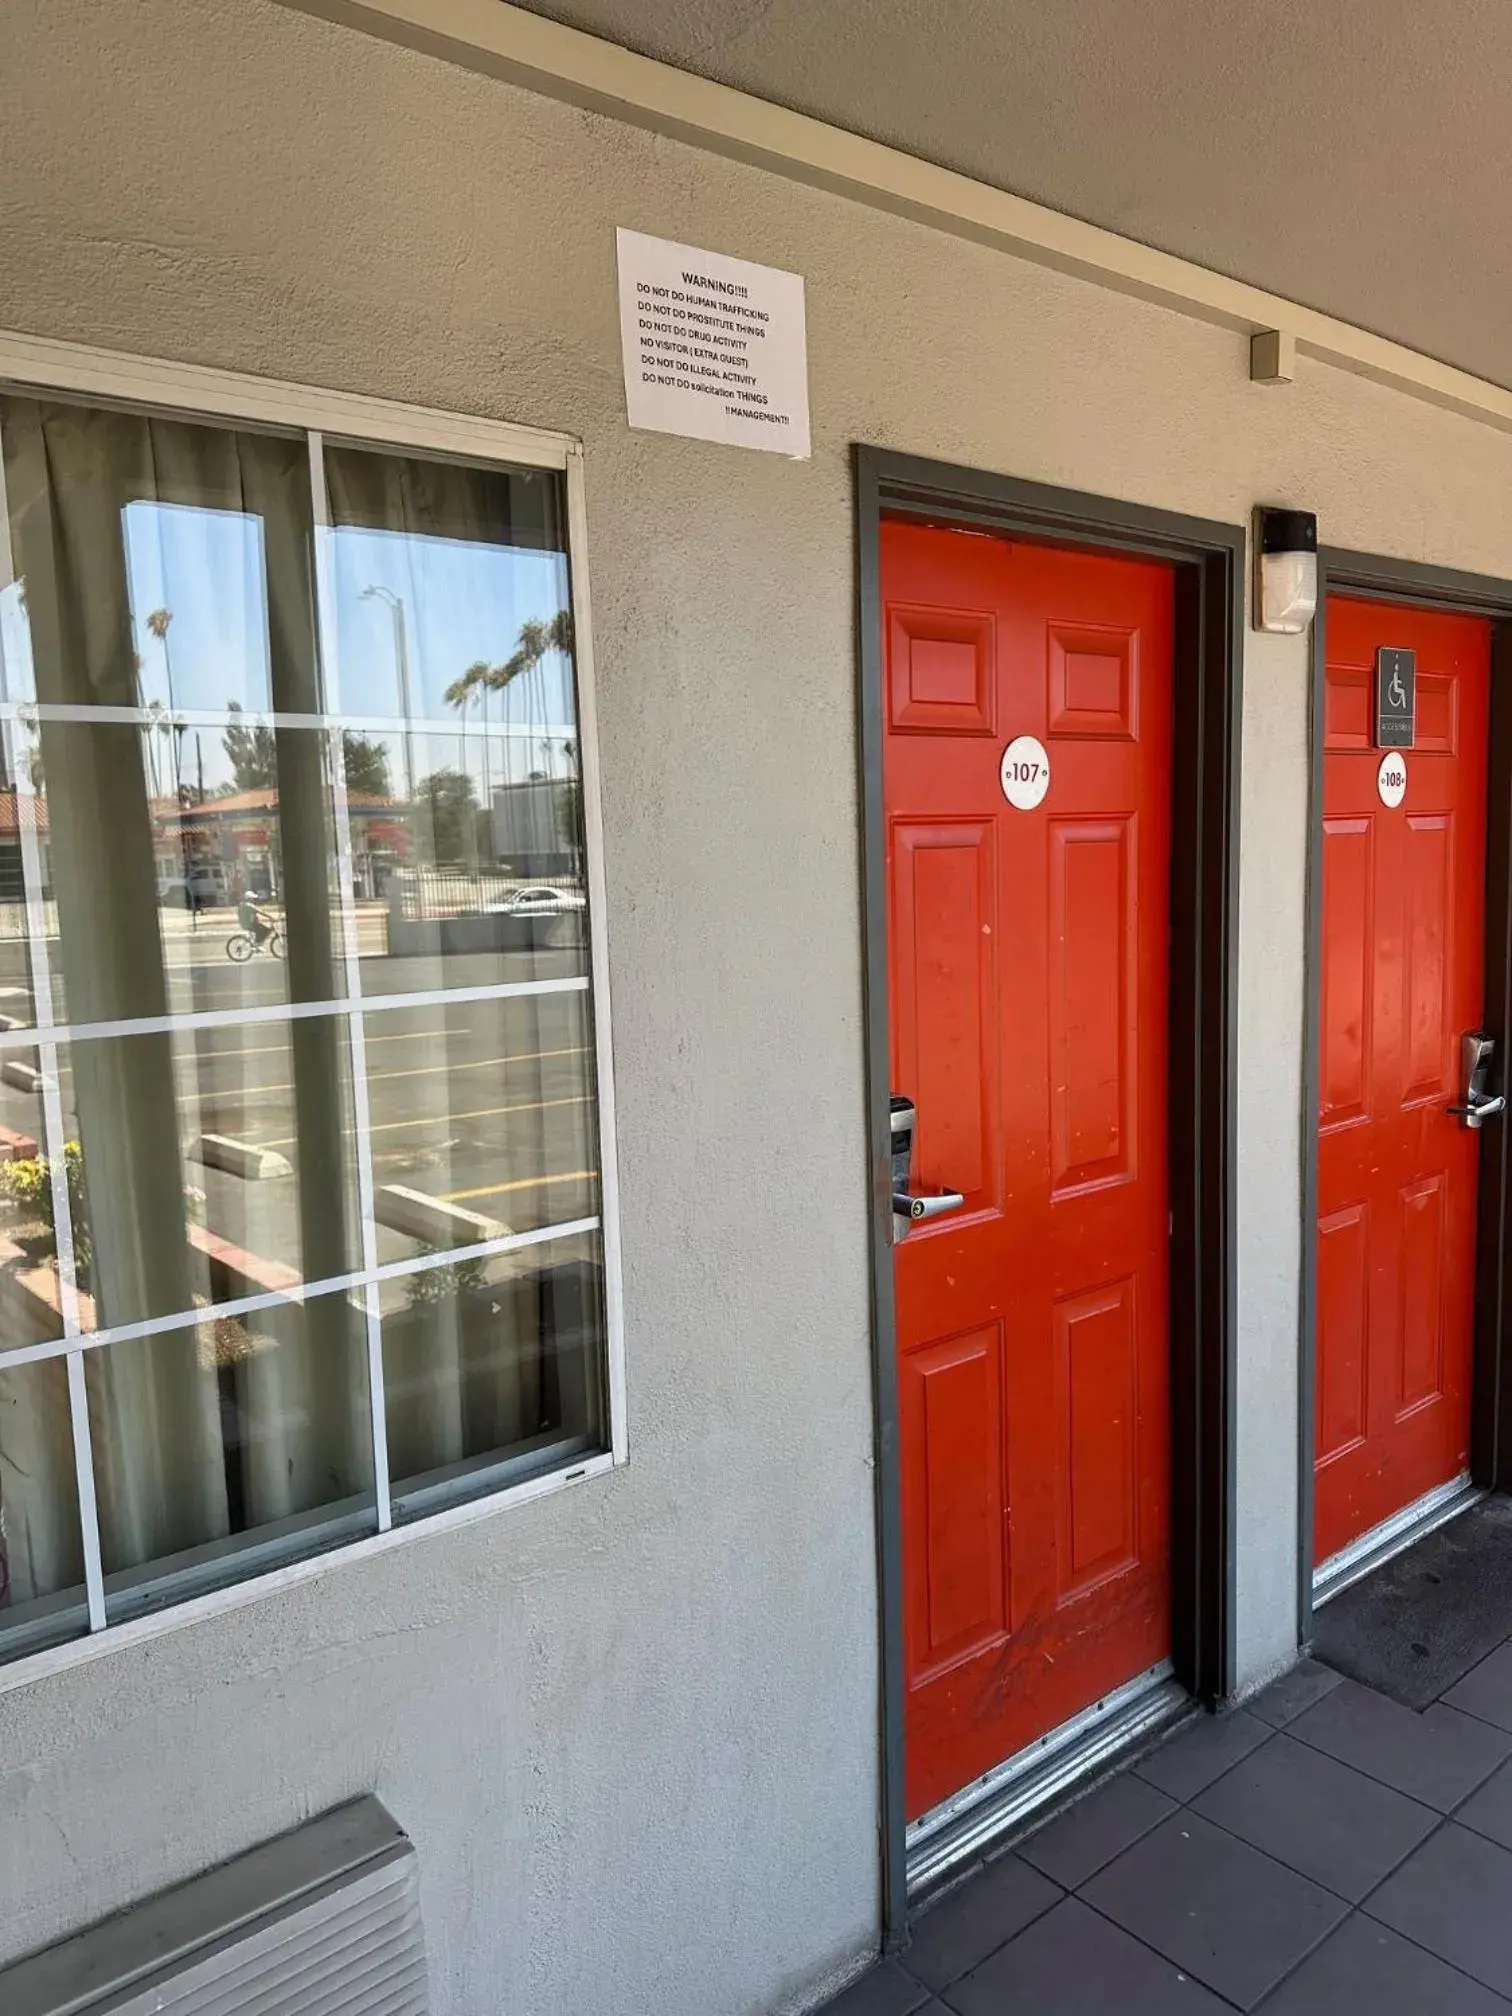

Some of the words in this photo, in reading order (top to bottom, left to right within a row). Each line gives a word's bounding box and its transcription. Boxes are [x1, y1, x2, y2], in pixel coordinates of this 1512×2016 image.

[636, 282, 651, 294] DO
[652, 286, 671, 298] NOT
[671, 290, 685, 301] DO
[686, 294, 717, 309] HUMAN
[718, 302, 770, 322] TRAFFICKING
[637, 300, 651, 312] DO
[653, 304, 671, 316] NOT
[672, 308, 686, 319] DO
[687, 311, 735, 331] PROSTITUTE
[736, 323, 766, 338] THINGS
[639, 319, 652, 330] DO
[654, 322, 672, 334] NOT
[673, 326, 687, 337] DO
[688, 329, 712, 343] DRUG
[713, 335, 748, 350] ACTIVITY
[640, 336, 654, 348] NO
[655, 340, 689, 355] VISITOR
[694, 347, 719, 362] EXTRA
[641, 354, 655, 365] DO
[656, 357, 675, 369] NOT
[676, 360, 689, 372] DO
[690, 364, 721, 379] ILLEGAL
[722, 371, 757, 386] ACTIVITY
[642, 372, 657, 383] DO
[658, 376, 676, 387] NOT
[677, 379, 690, 390] DO
[691, 382, 735, 398] solicitation
[736, 390, 769, 405] THINGS
[1013, 762, 1039, 783] 107
[1385, 772, 1401, 787] 108
